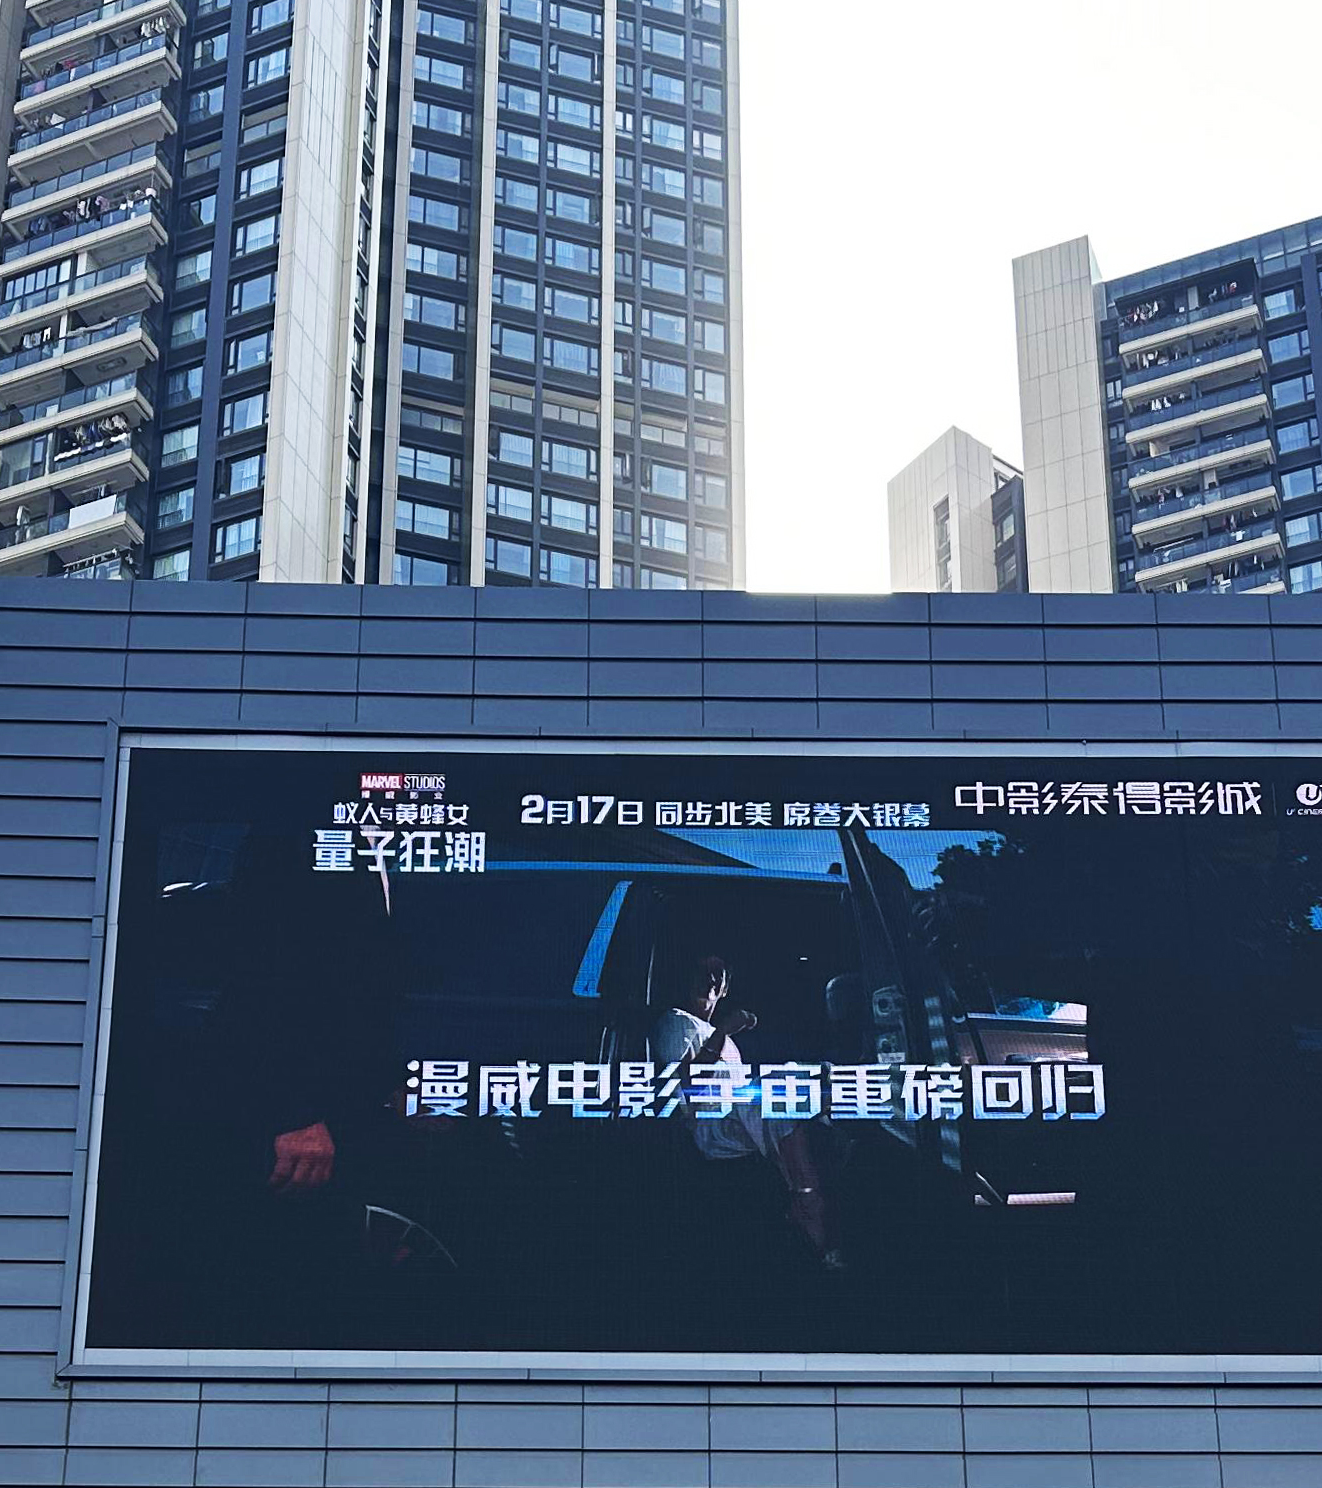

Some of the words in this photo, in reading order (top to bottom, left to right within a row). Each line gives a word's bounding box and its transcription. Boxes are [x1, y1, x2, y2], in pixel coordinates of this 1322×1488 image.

[361, 774, 402, 789] MARVEL
[404, 775, 446, 790] STUDIOS
[332, 801, 470, 826] 蚁人与黄蜂女
[520, 794, 644, 825] 2月17日
[654, 800, 773, 827] 同步北美
[782, 801, 931, 828] 席卷大银幕
[312, 829, 486, 873] 量子狂潮
[405, 1059, 1107, 1120] 漫威电影宇宙重磅回归
